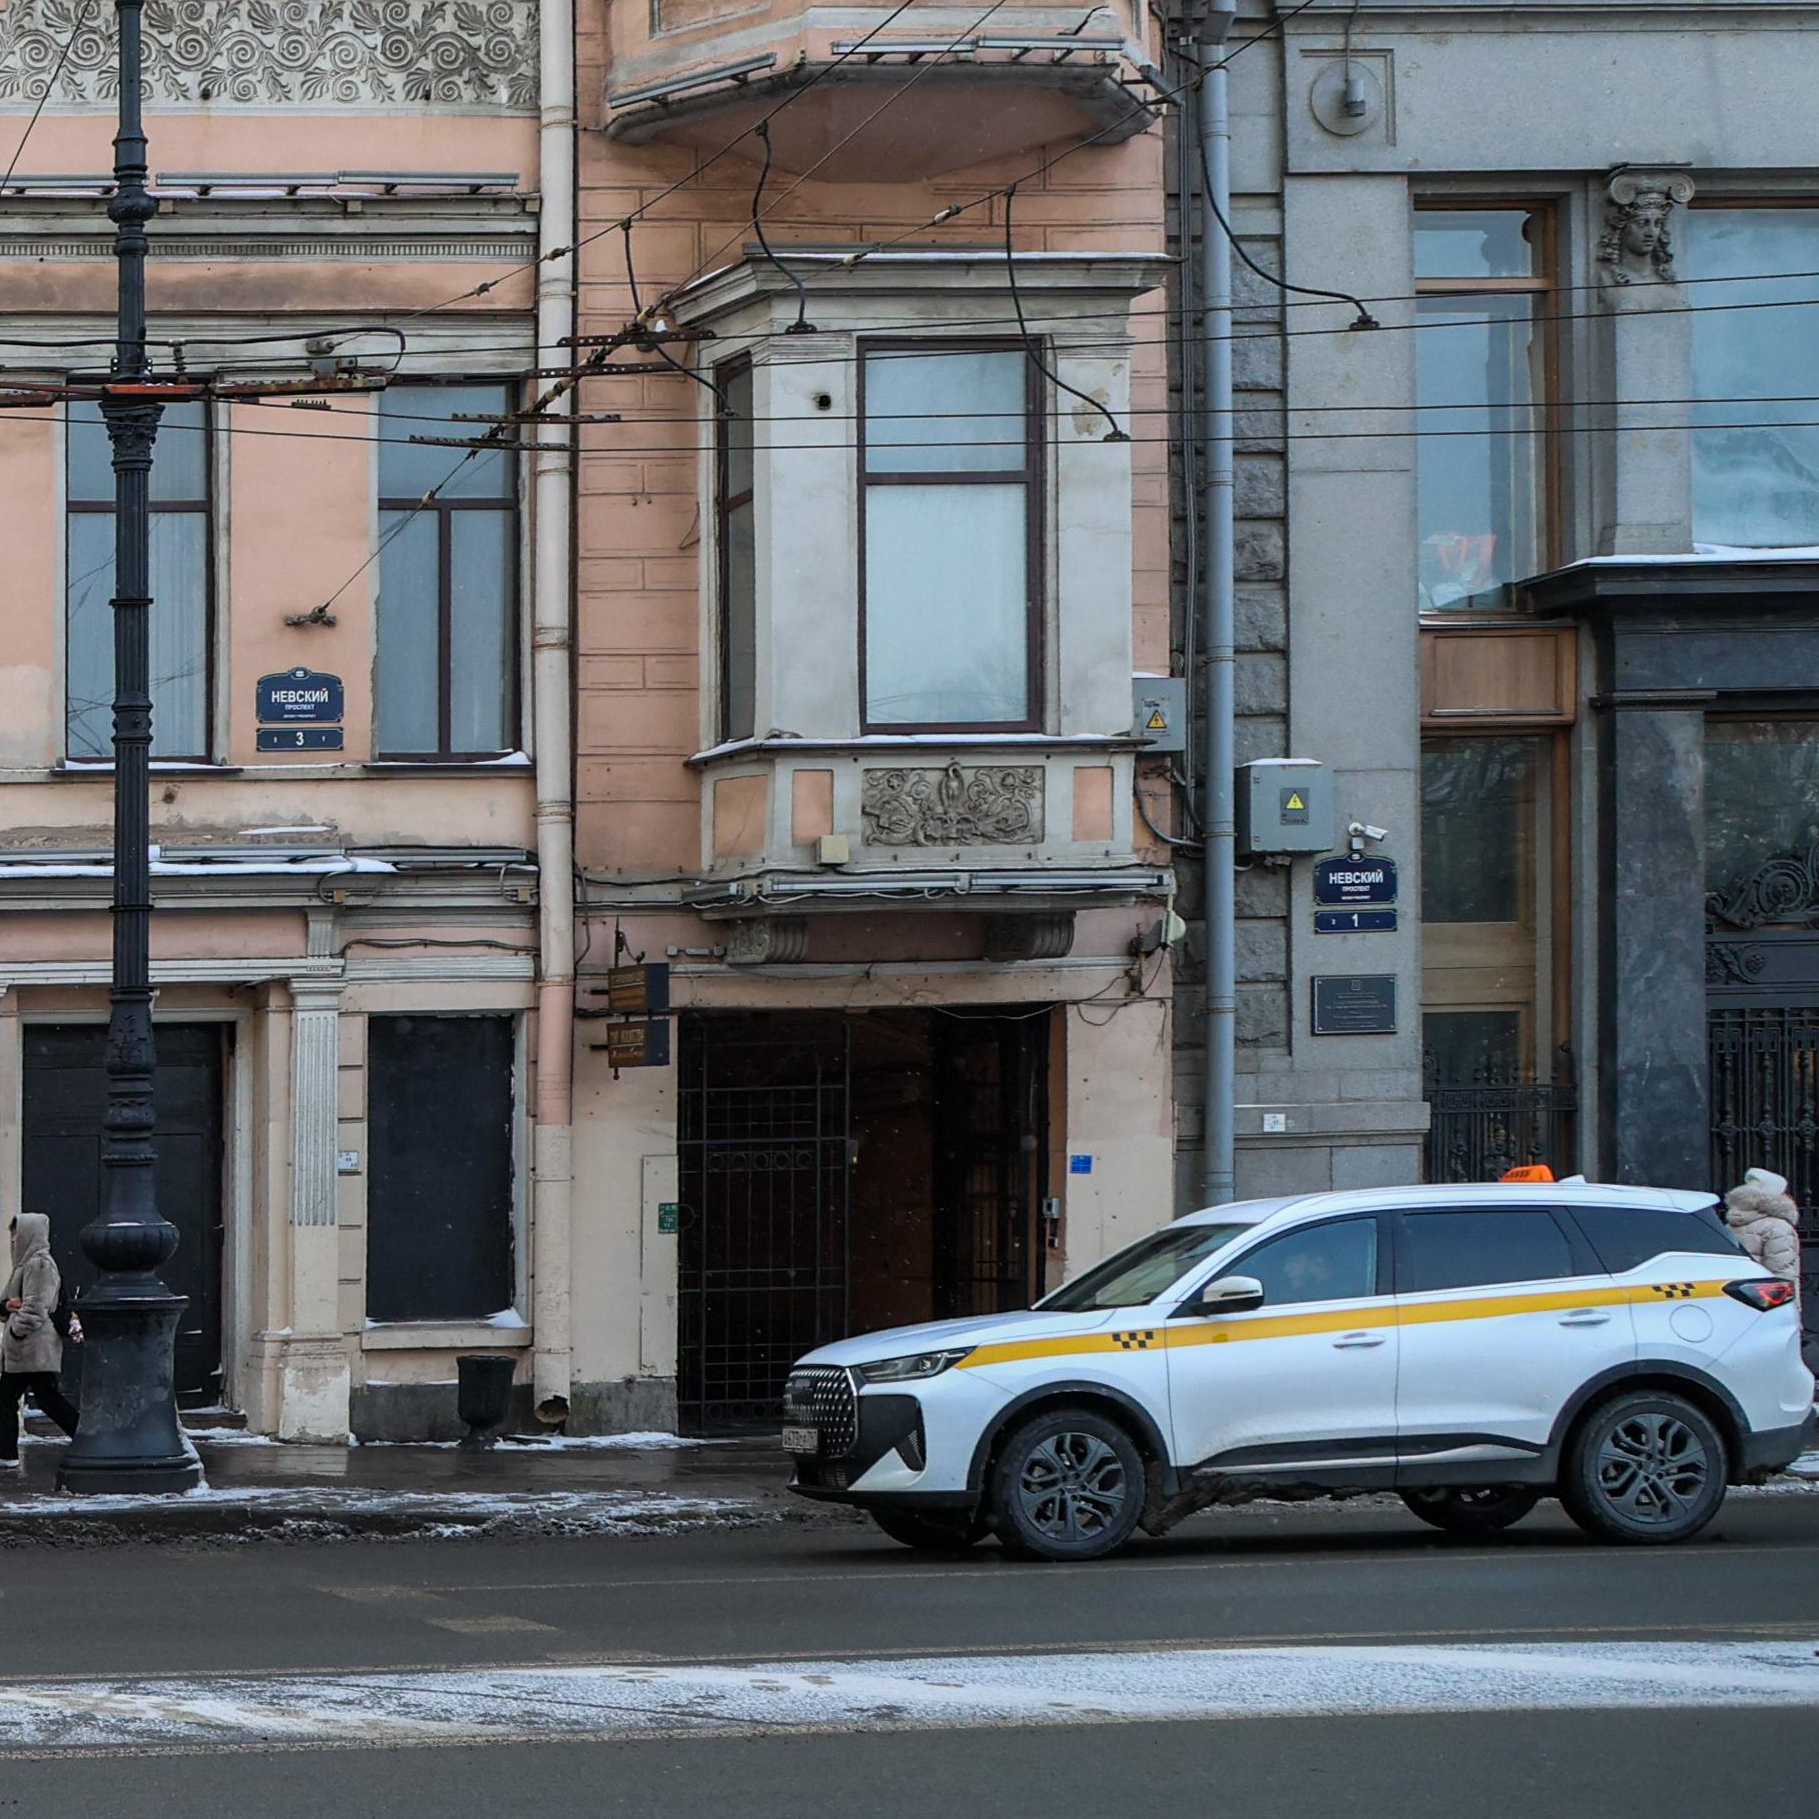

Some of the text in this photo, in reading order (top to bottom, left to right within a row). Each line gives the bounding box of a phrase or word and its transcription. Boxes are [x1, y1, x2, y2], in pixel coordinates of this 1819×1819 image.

[271, 688, 329, 703] НЕВСКИЙ
[295, 732, 304, 746] 3
[1329, 869, 1383, 884] НЕВСКИЙ
[1352, 913, 1358, 927] 1
